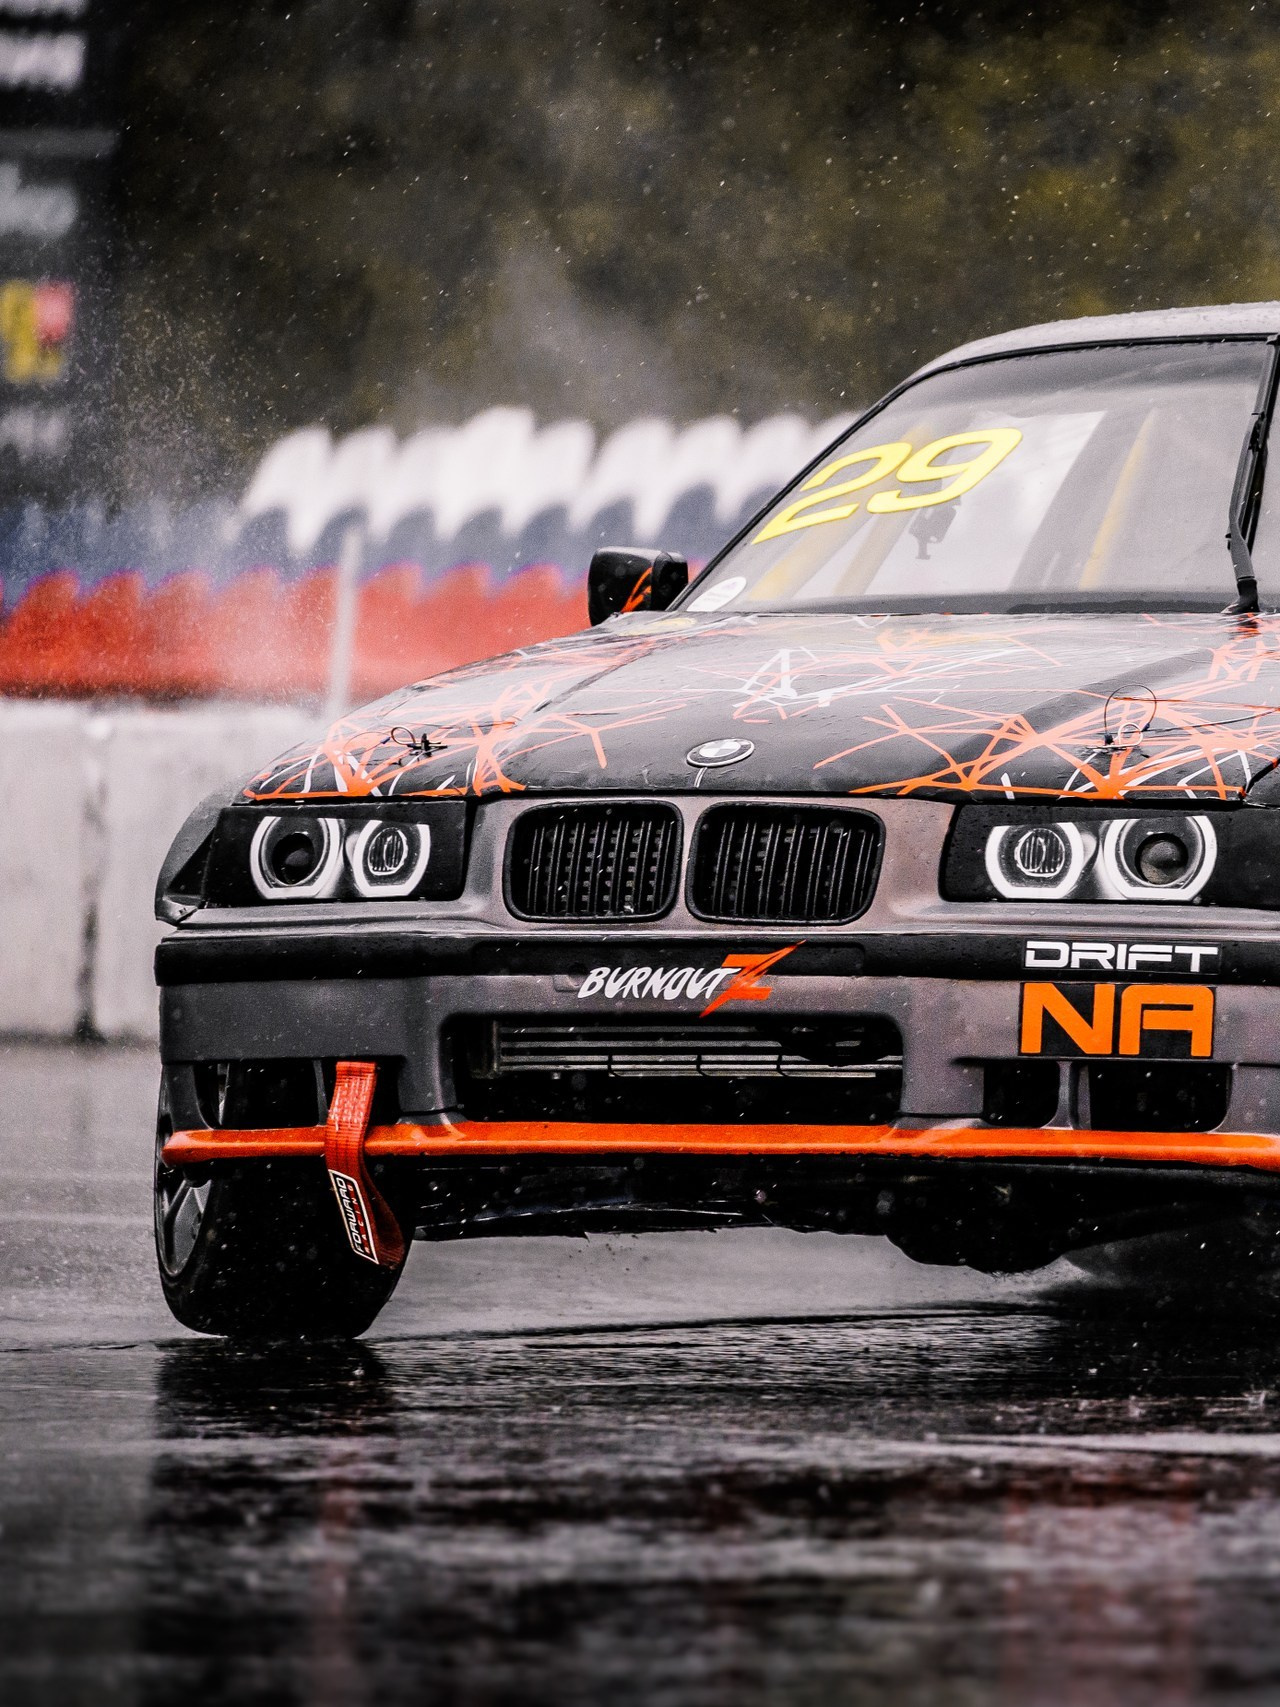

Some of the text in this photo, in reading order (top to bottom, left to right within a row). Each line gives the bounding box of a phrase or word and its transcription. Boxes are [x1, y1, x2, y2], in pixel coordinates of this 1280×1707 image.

[751, 427, 1023, 545] 29
[1025, 940, 1218, 973] DRIFT
[1020, 982, 1214, 1057] NA
[335, 1176, 365, 1254] FORWARD
[346, 1183, 371, 1254] RACING
